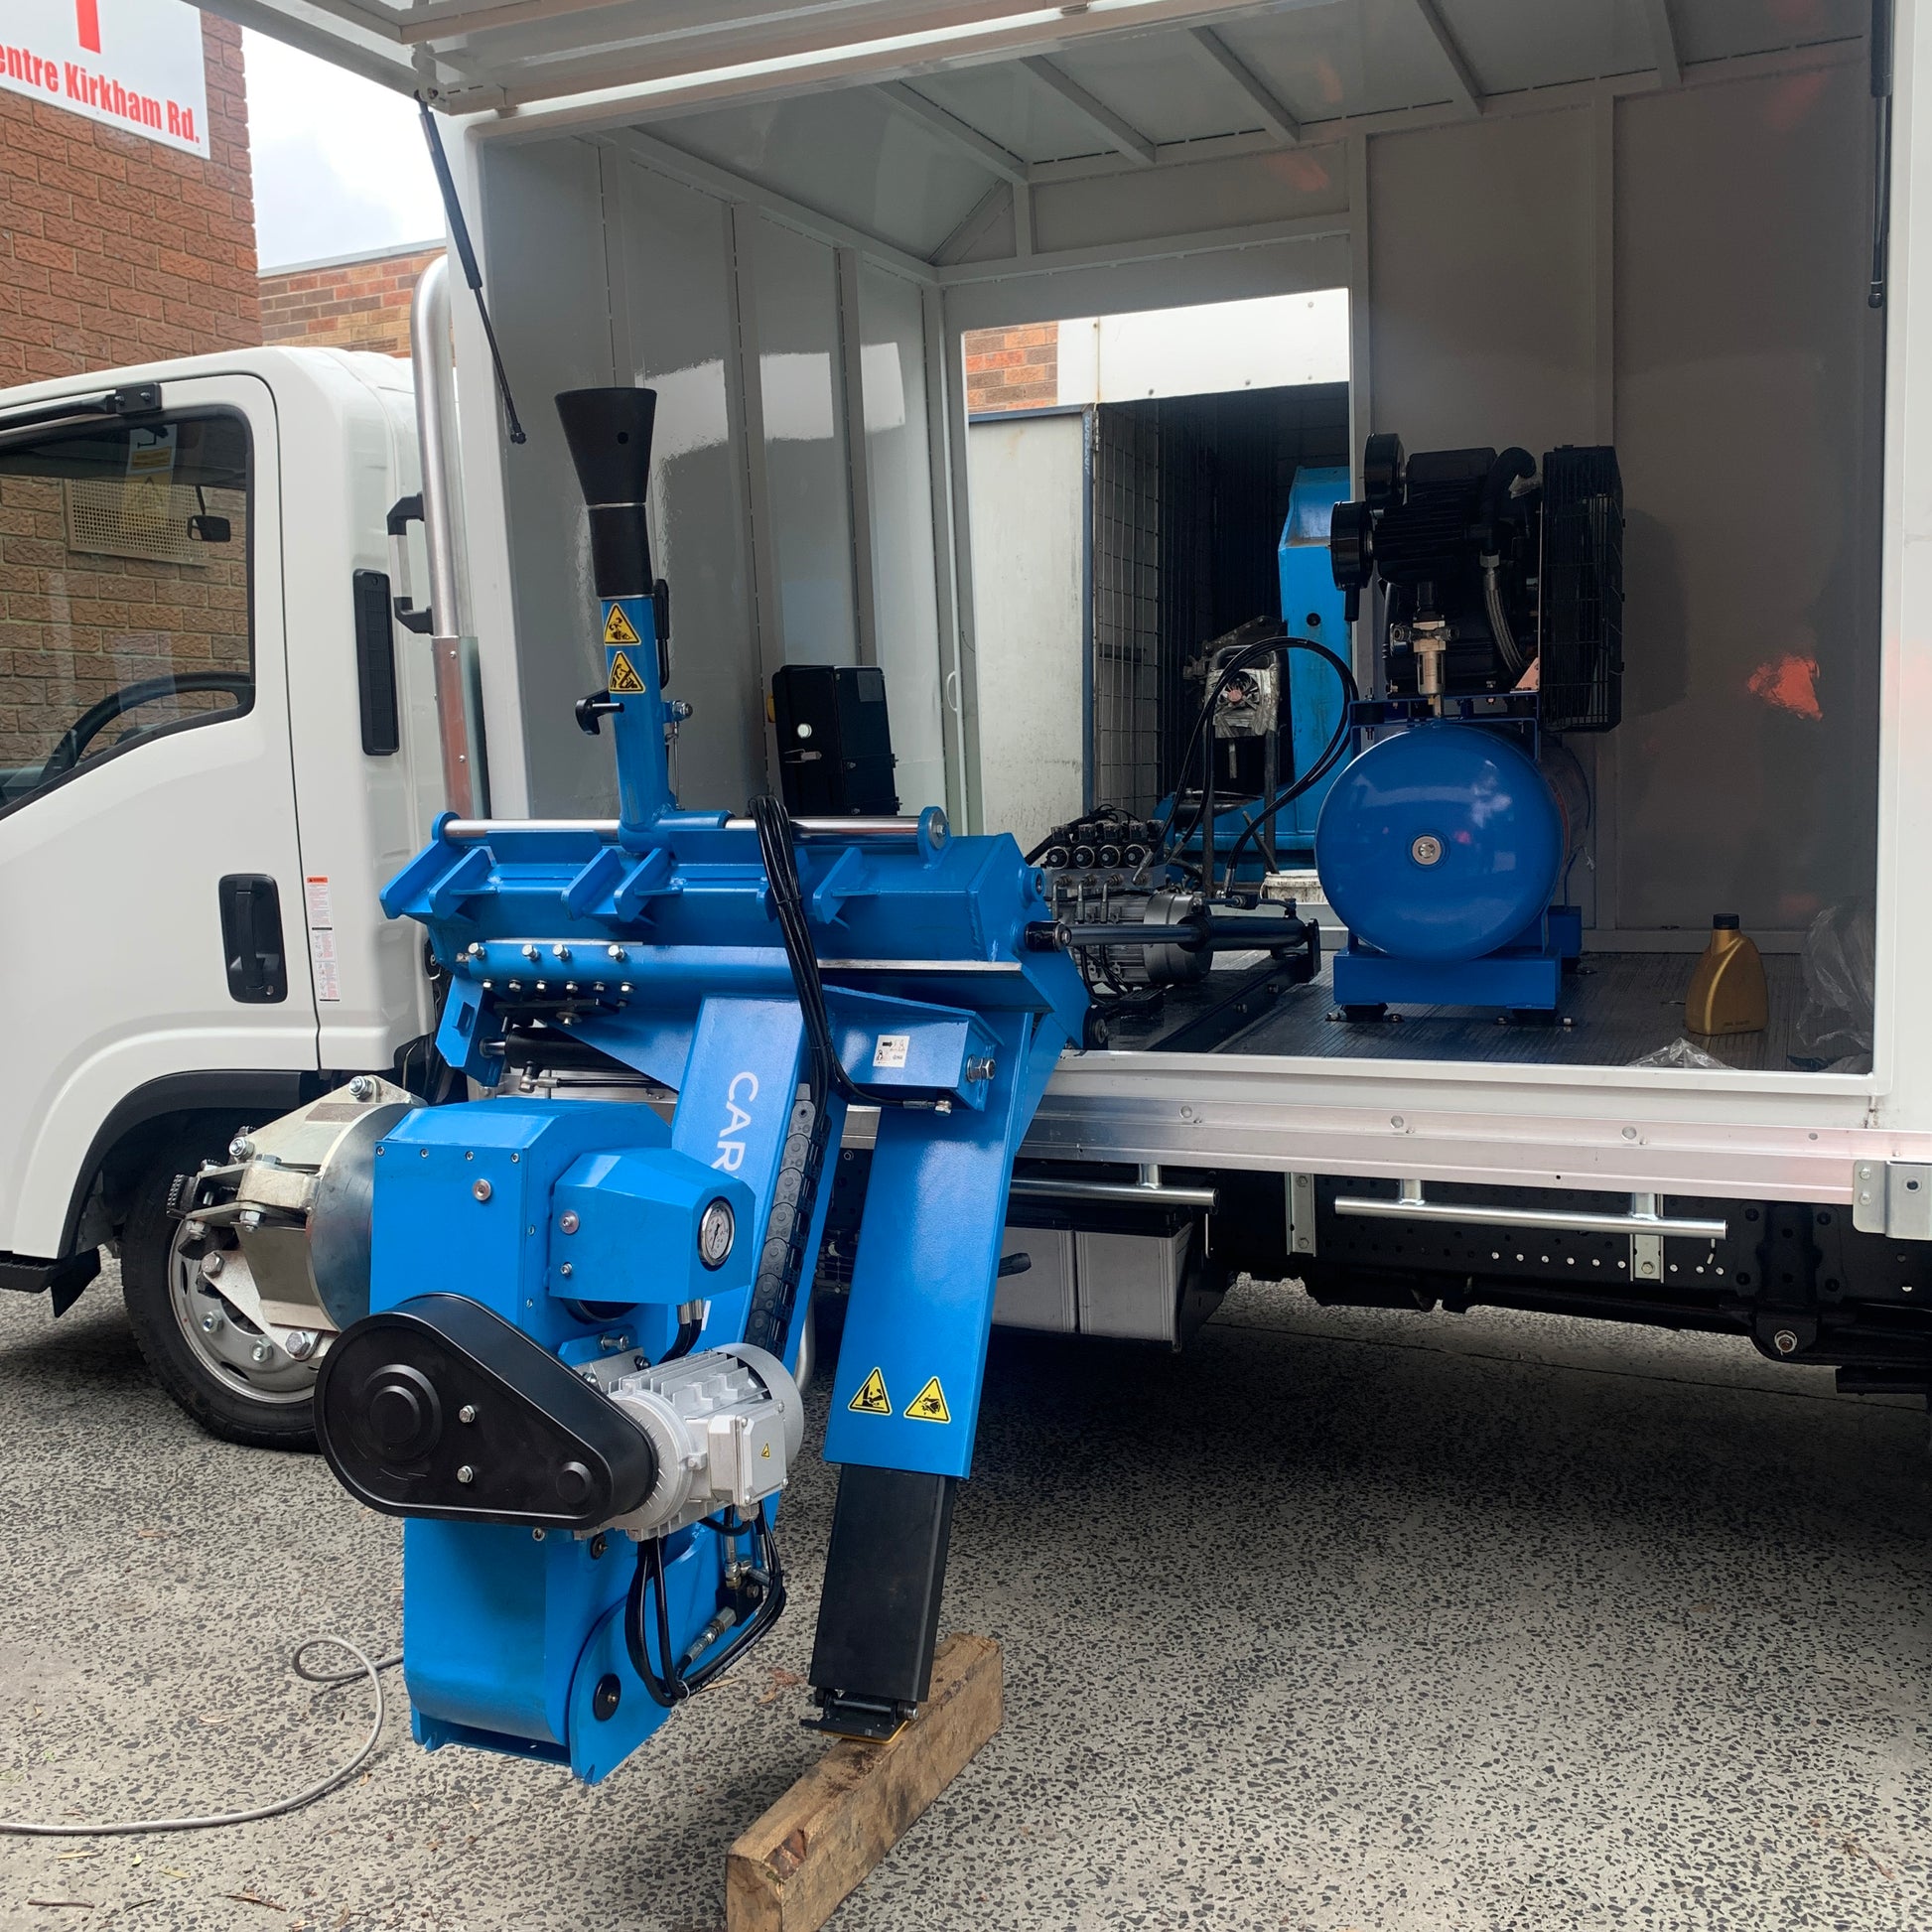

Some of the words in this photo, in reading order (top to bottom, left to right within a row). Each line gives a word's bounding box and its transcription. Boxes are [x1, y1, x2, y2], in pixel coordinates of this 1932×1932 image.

[65, 62, 163, 130] Kirkham
[167, 100, 200, 143] Rd.
[711, 1072, 759, 1178] CAR
